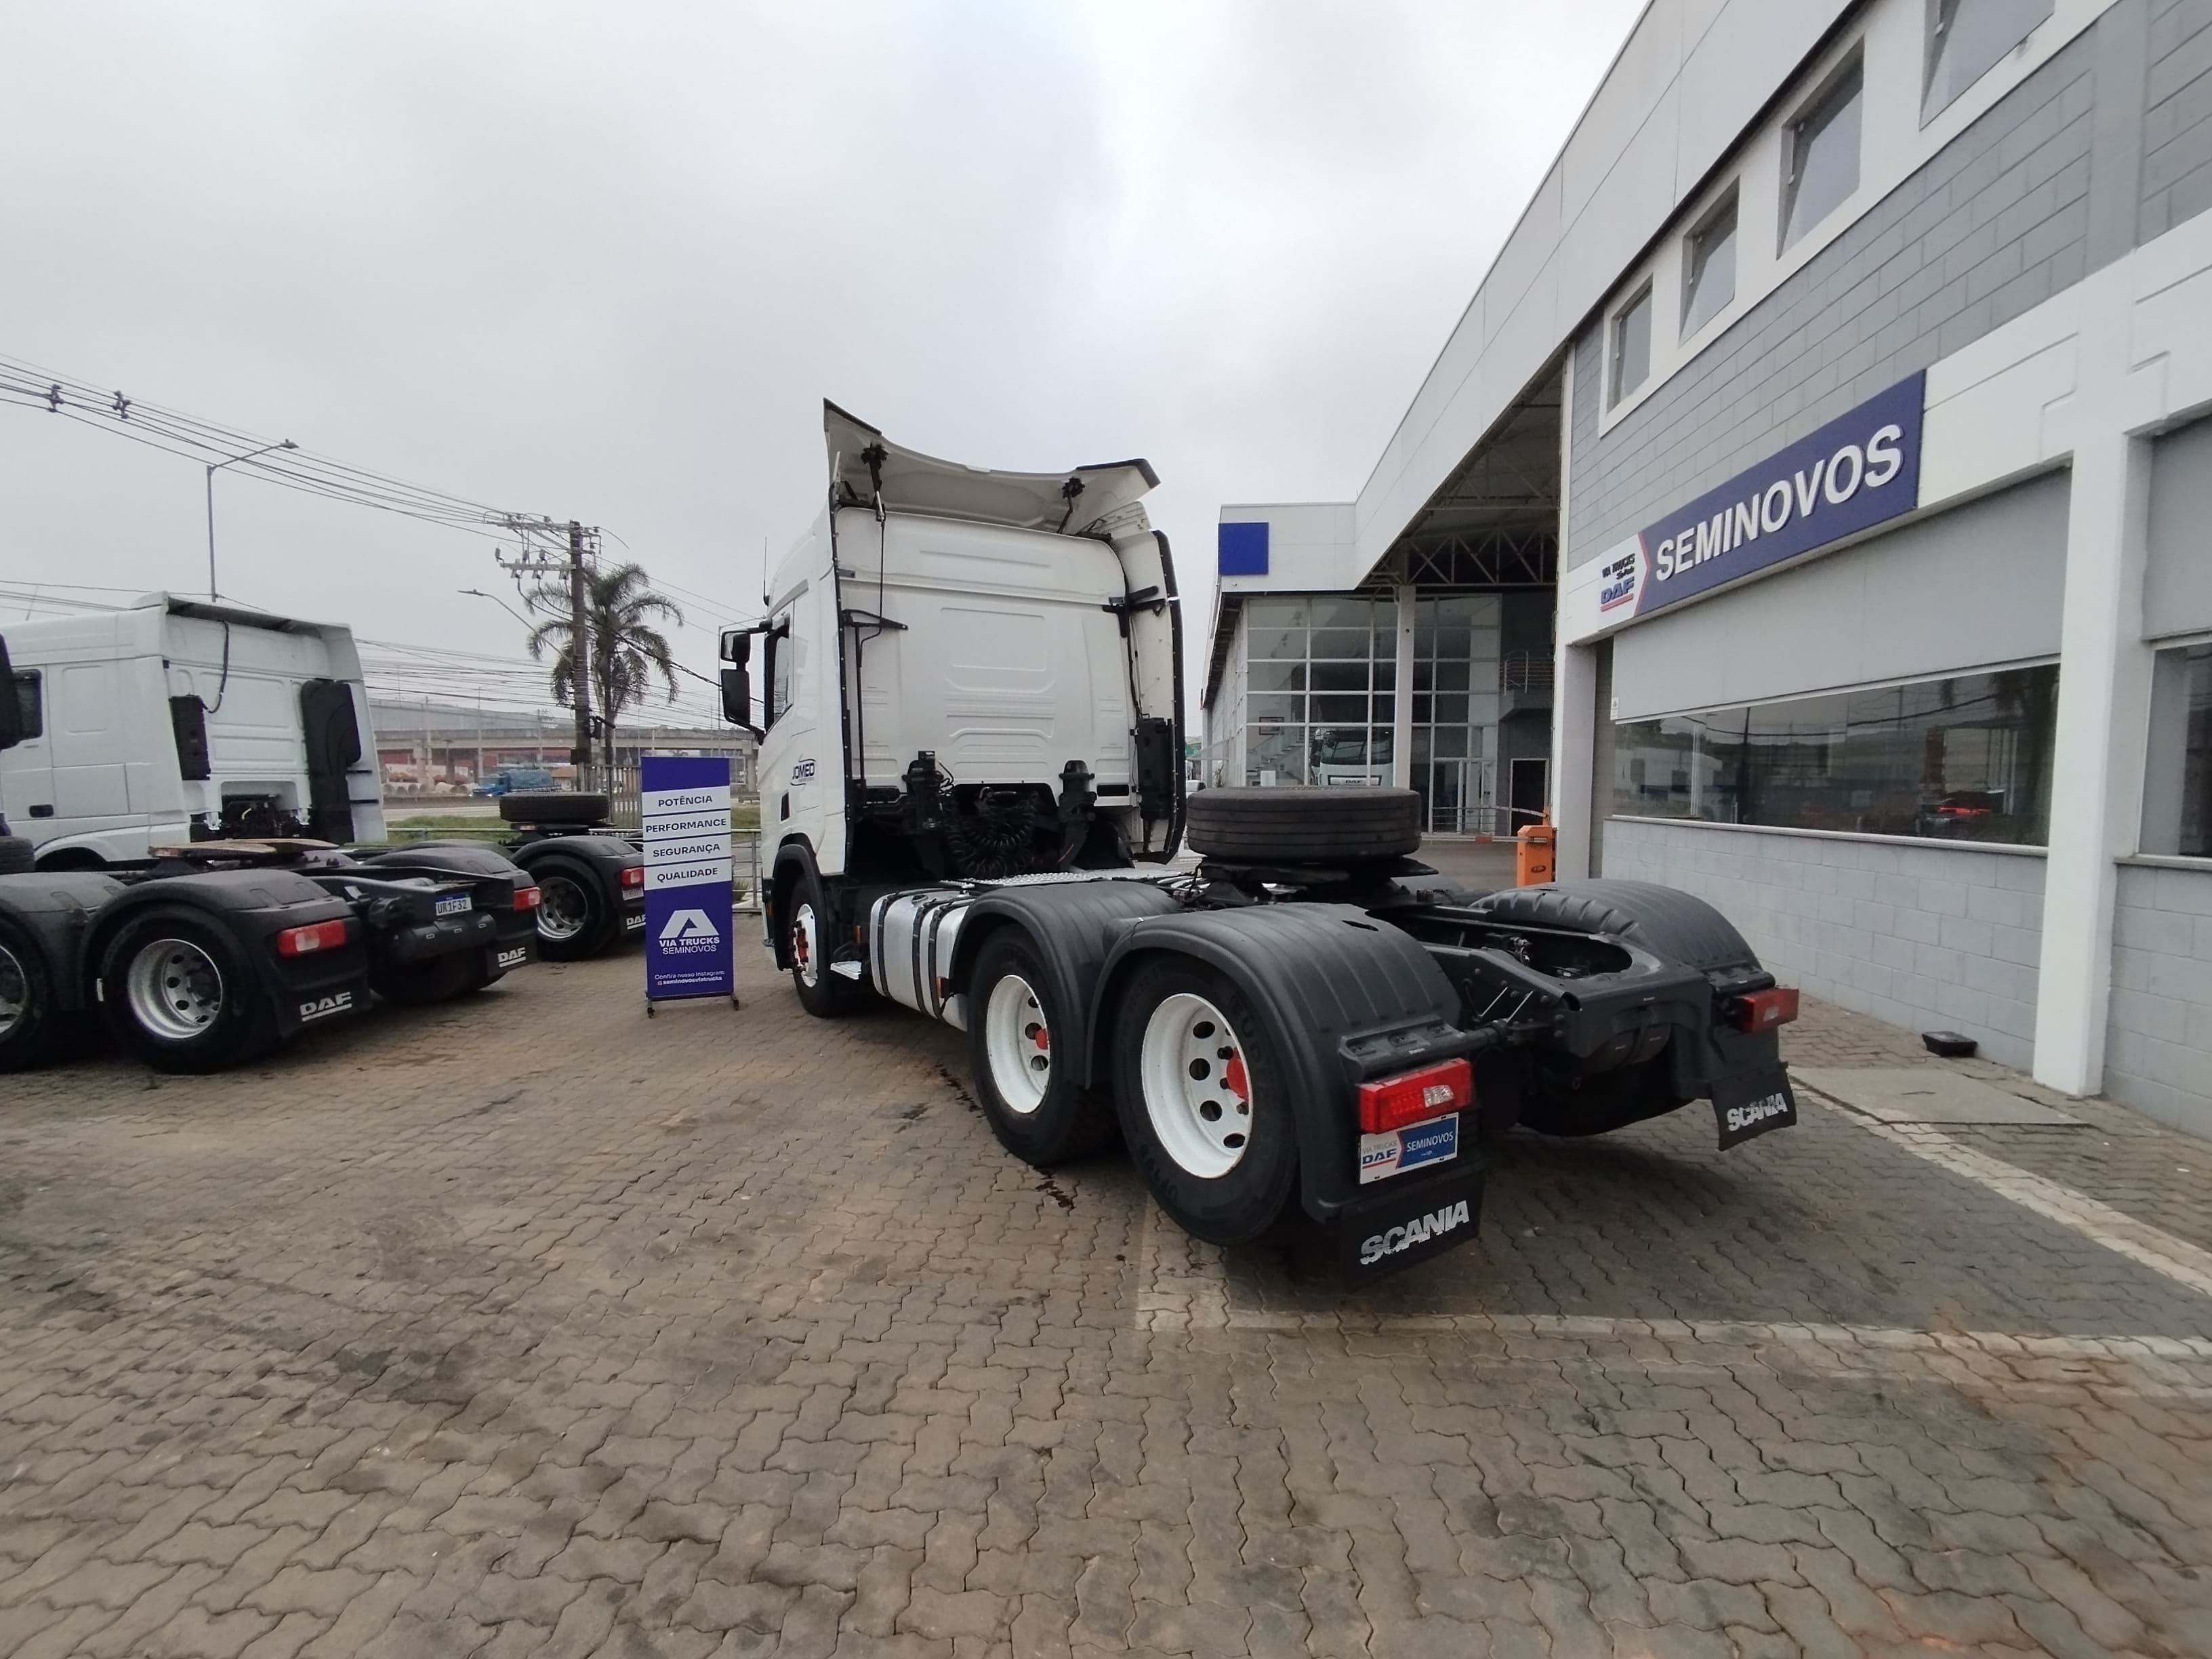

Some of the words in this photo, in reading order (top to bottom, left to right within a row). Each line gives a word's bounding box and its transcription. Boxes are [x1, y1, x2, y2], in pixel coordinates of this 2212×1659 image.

[1656, 424, 1903, 581] SEMINOVOS
[1601, 576, 1635, 605] DAF
[658, 795, 713, 807] POTÊNCIA
[646, 818, 726, 833] PERFORMANCE
[653, 843, 720, 857] SEGURANÇA
[657, 867, 718, 883] QUALIDADE
[659, 939, 677, 947] VIA
[678, 937, 720, 946] TRUCKS
[662, 944, 717, 955] SEMINOVOS
[498, 947, 527, 963] DAF
[300, 991, 352, 1017] DAF
[1727, 1092, 1788, 1132] SCANIA
[1406, 1131, 1454, 1152] SEMINOVOS
[1362, 1148, 1397, 1165] DAF
[1360, 1200, 1470, 1265] SCANIA
